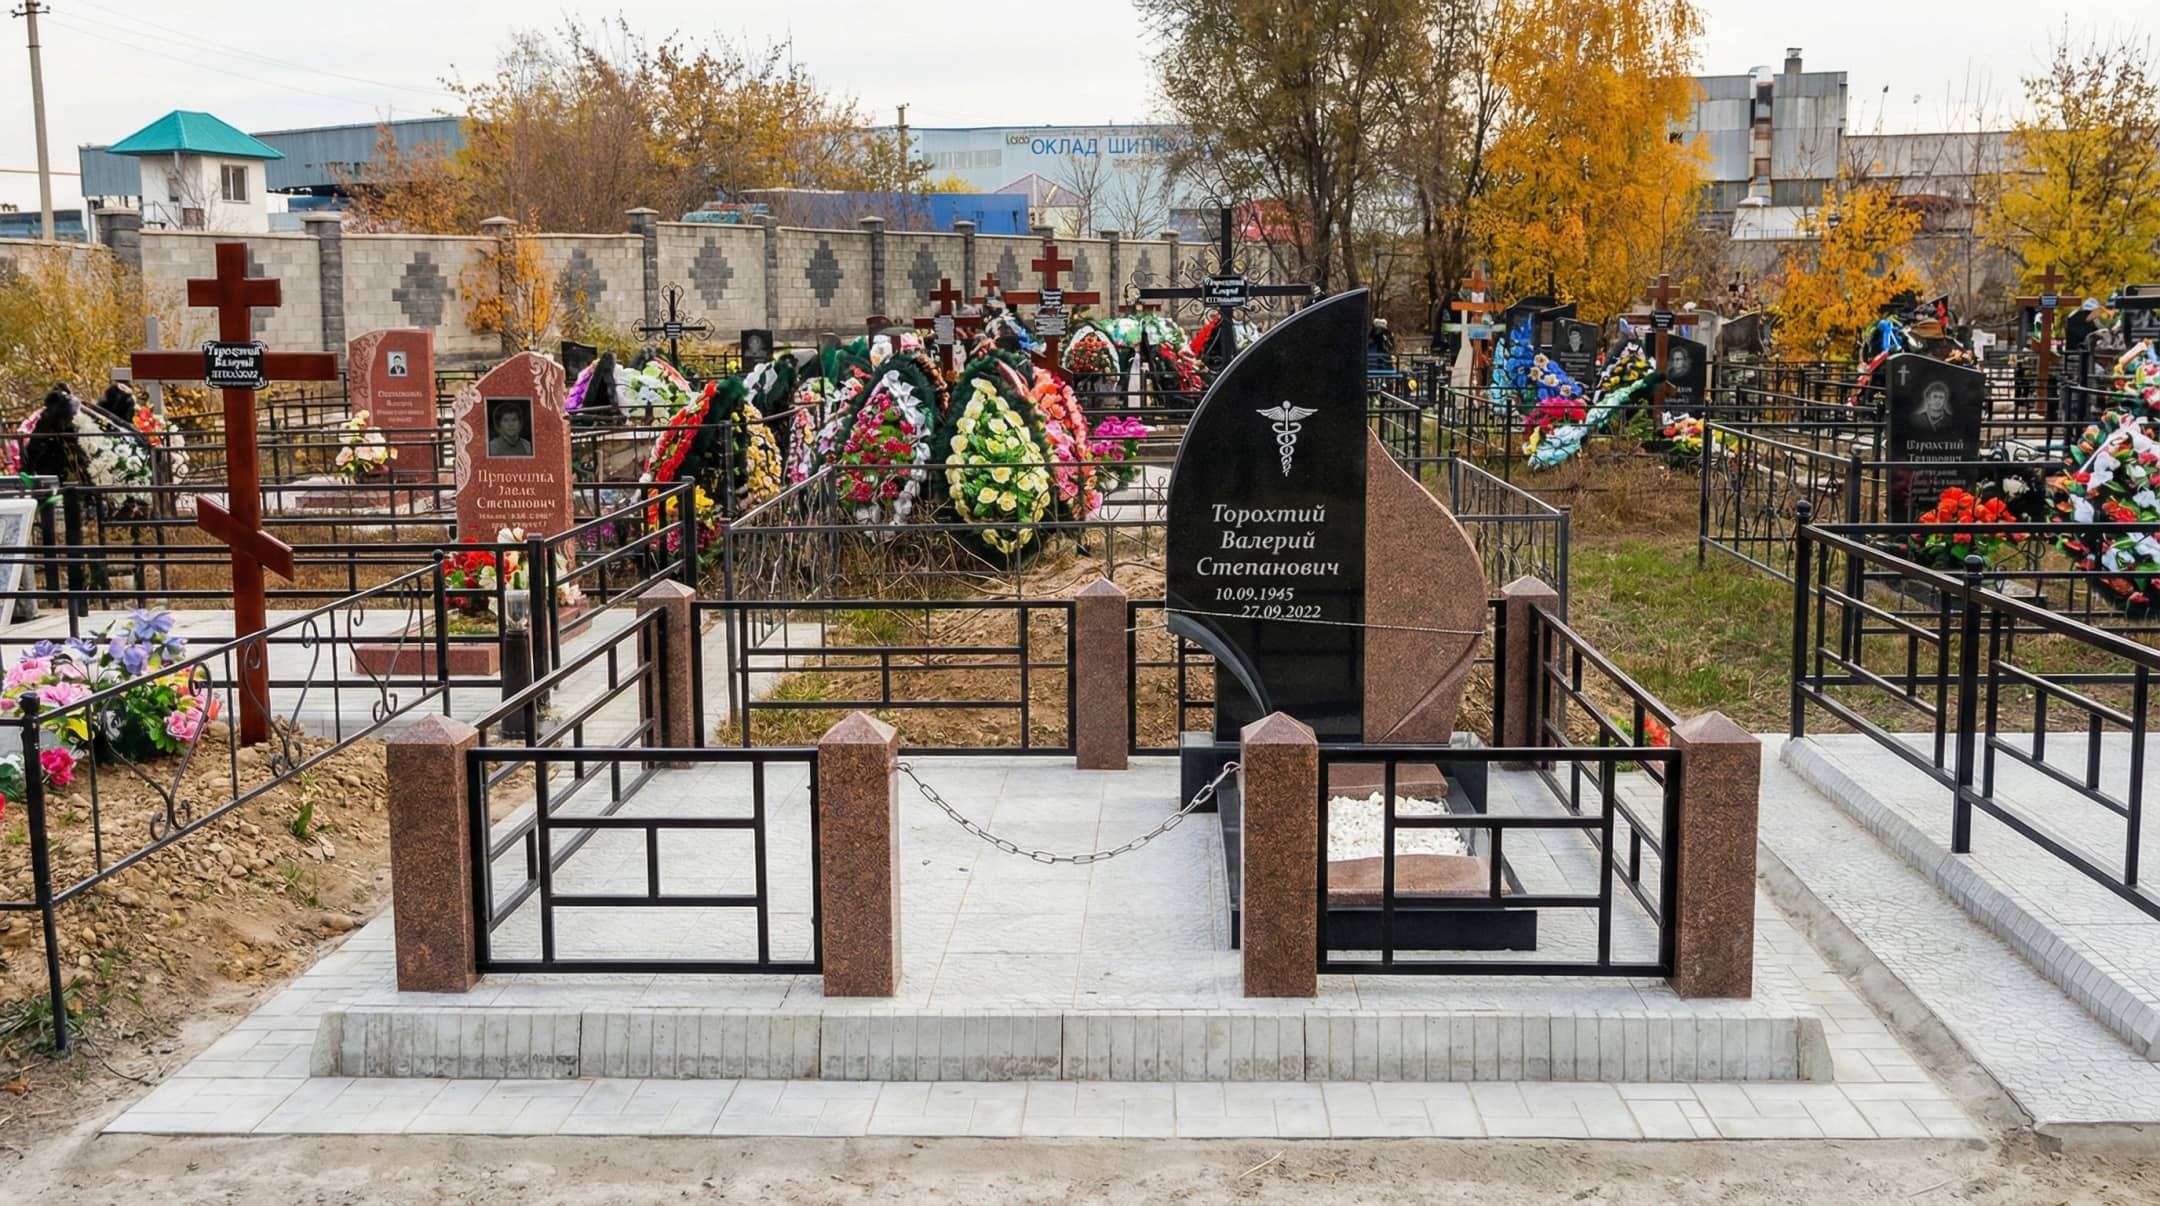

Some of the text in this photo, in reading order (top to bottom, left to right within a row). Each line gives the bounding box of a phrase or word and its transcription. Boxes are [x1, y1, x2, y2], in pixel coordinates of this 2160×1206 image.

[1212, 503, 1325, 528] Торохтий
[1220, 530, 1316, 555] Валерий
[1196, 556, 1340, 576] Степанович
[1242, 604, 1322, 619] 27.09.2022
